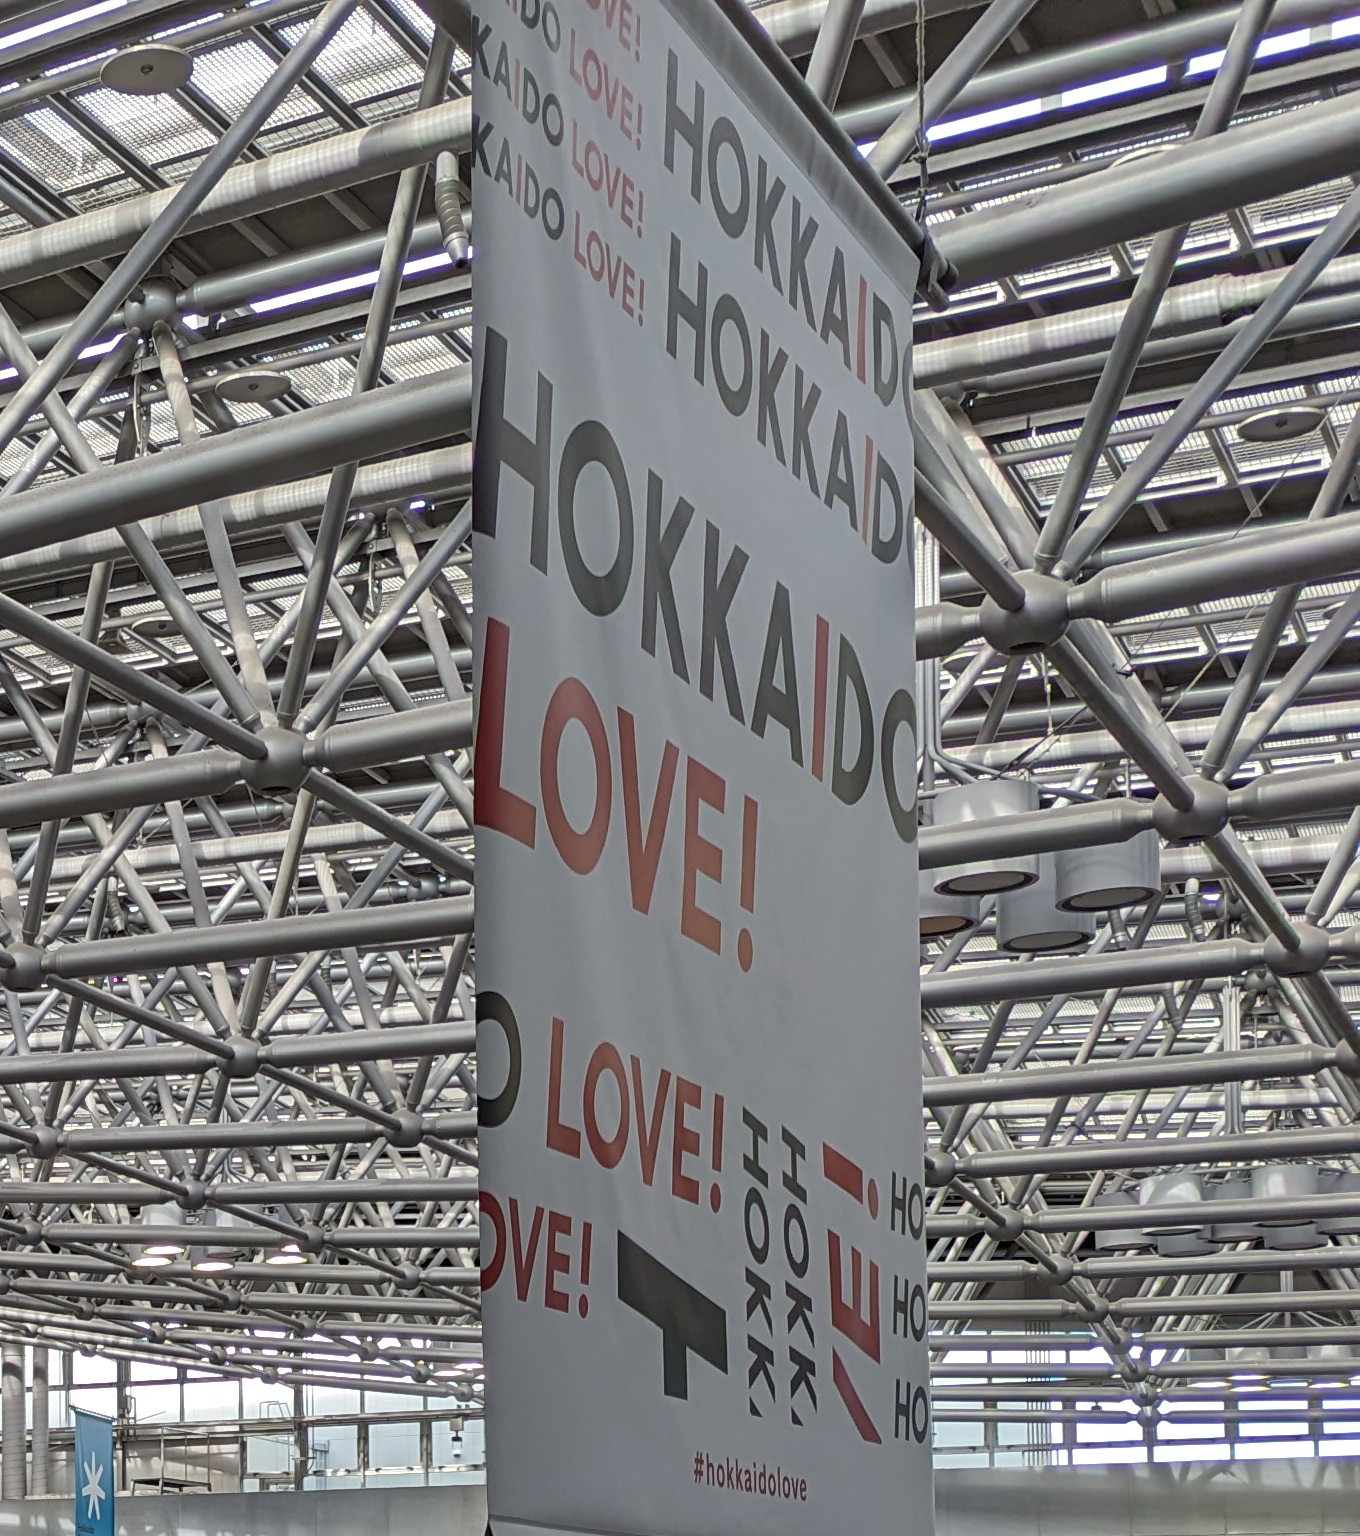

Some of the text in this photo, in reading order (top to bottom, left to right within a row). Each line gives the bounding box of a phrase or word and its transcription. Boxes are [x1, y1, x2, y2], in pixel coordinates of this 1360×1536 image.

[570, 28, 643, 151] LOVE!
[572, 119, 644, 238] LOVE!
[574, 212, 645, 327] LOVE!
[474, 616, 758, 973] LOVE!
[546, 1018, 724, 1214] LOVE!
[693, 1451, 808, 1501] #hokkaidolove
